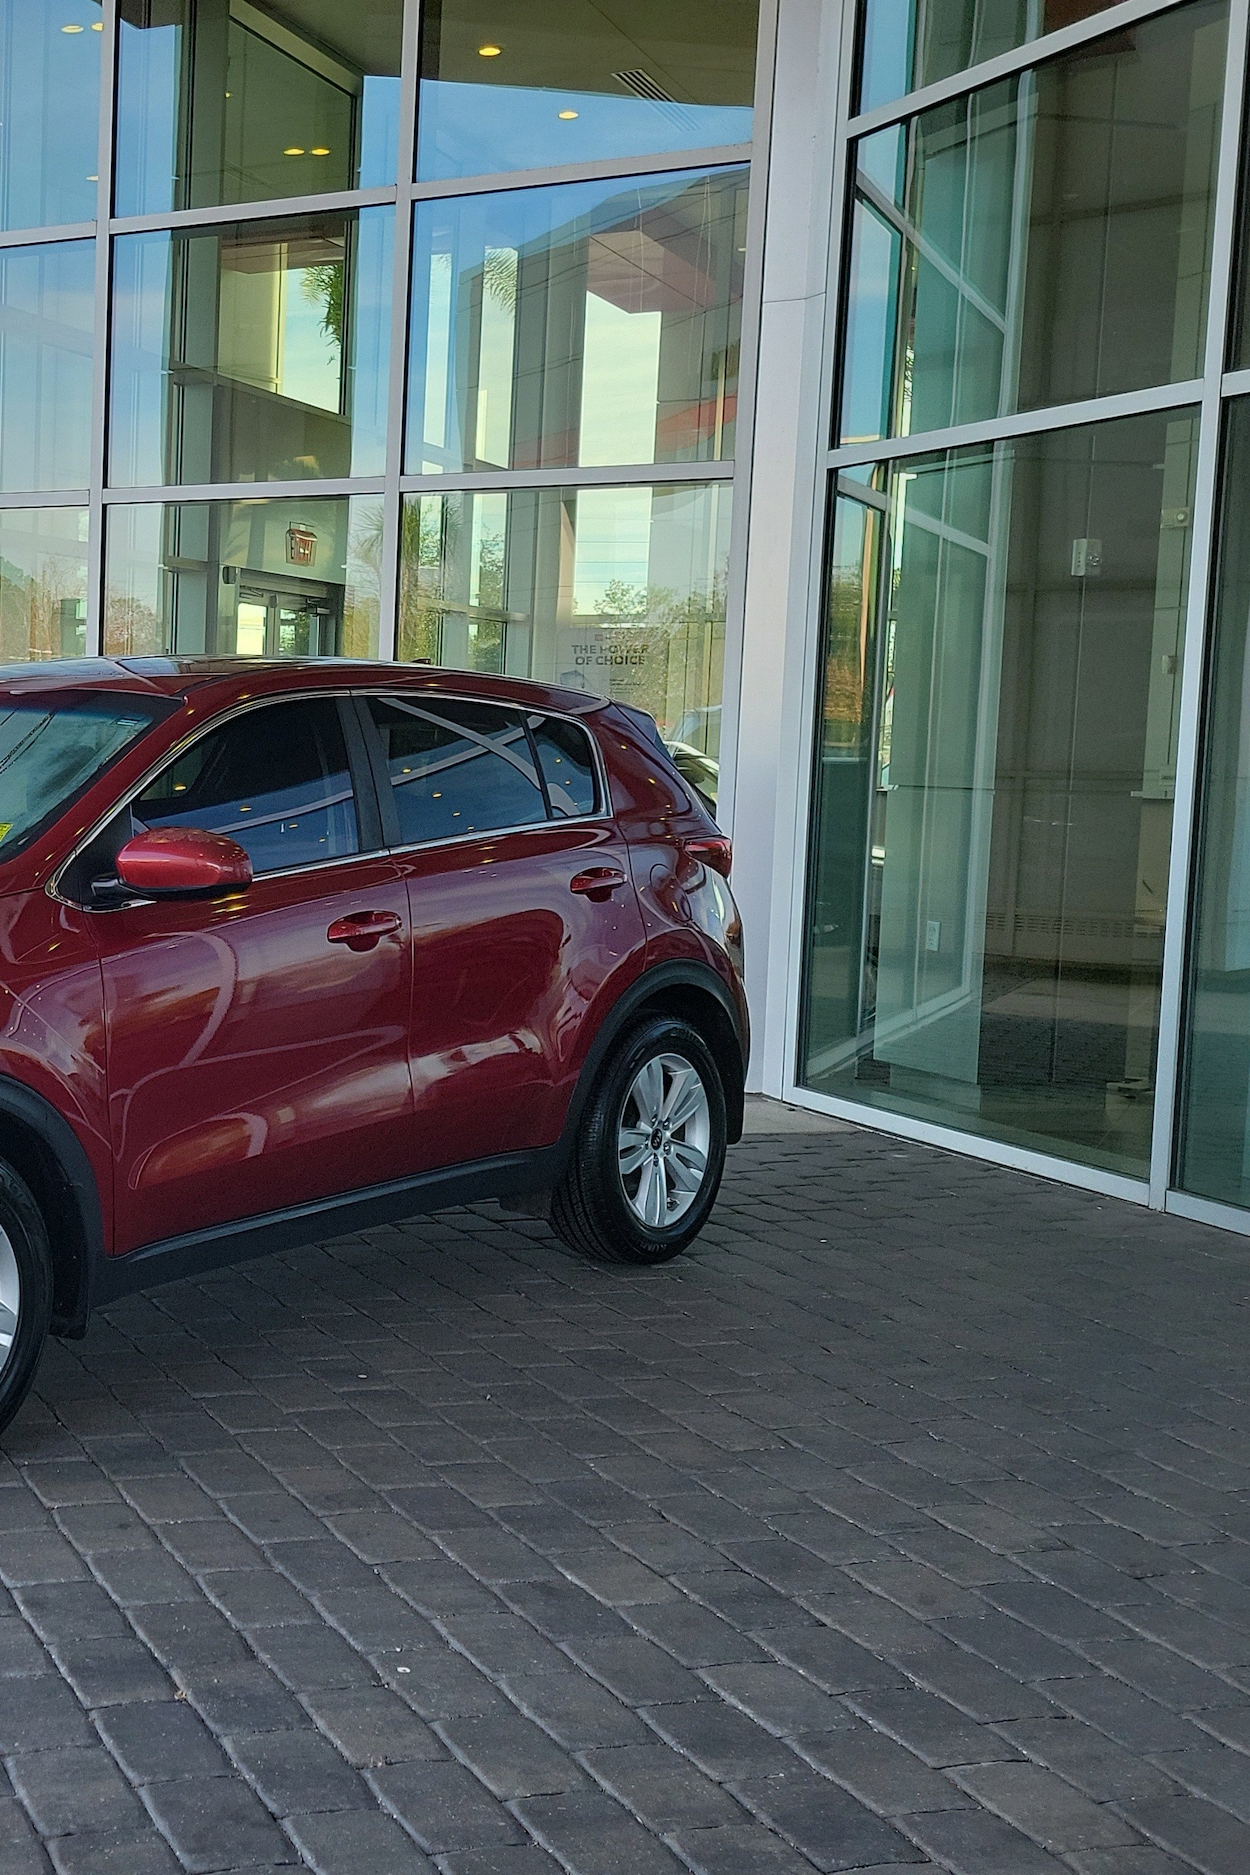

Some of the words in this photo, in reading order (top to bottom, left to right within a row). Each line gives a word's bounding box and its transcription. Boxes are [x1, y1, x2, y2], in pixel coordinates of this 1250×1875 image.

[571, 644, 597, 655] THE
[575, 655, 593, 666] OF
[595, 655, 645, 666] CHOICE
